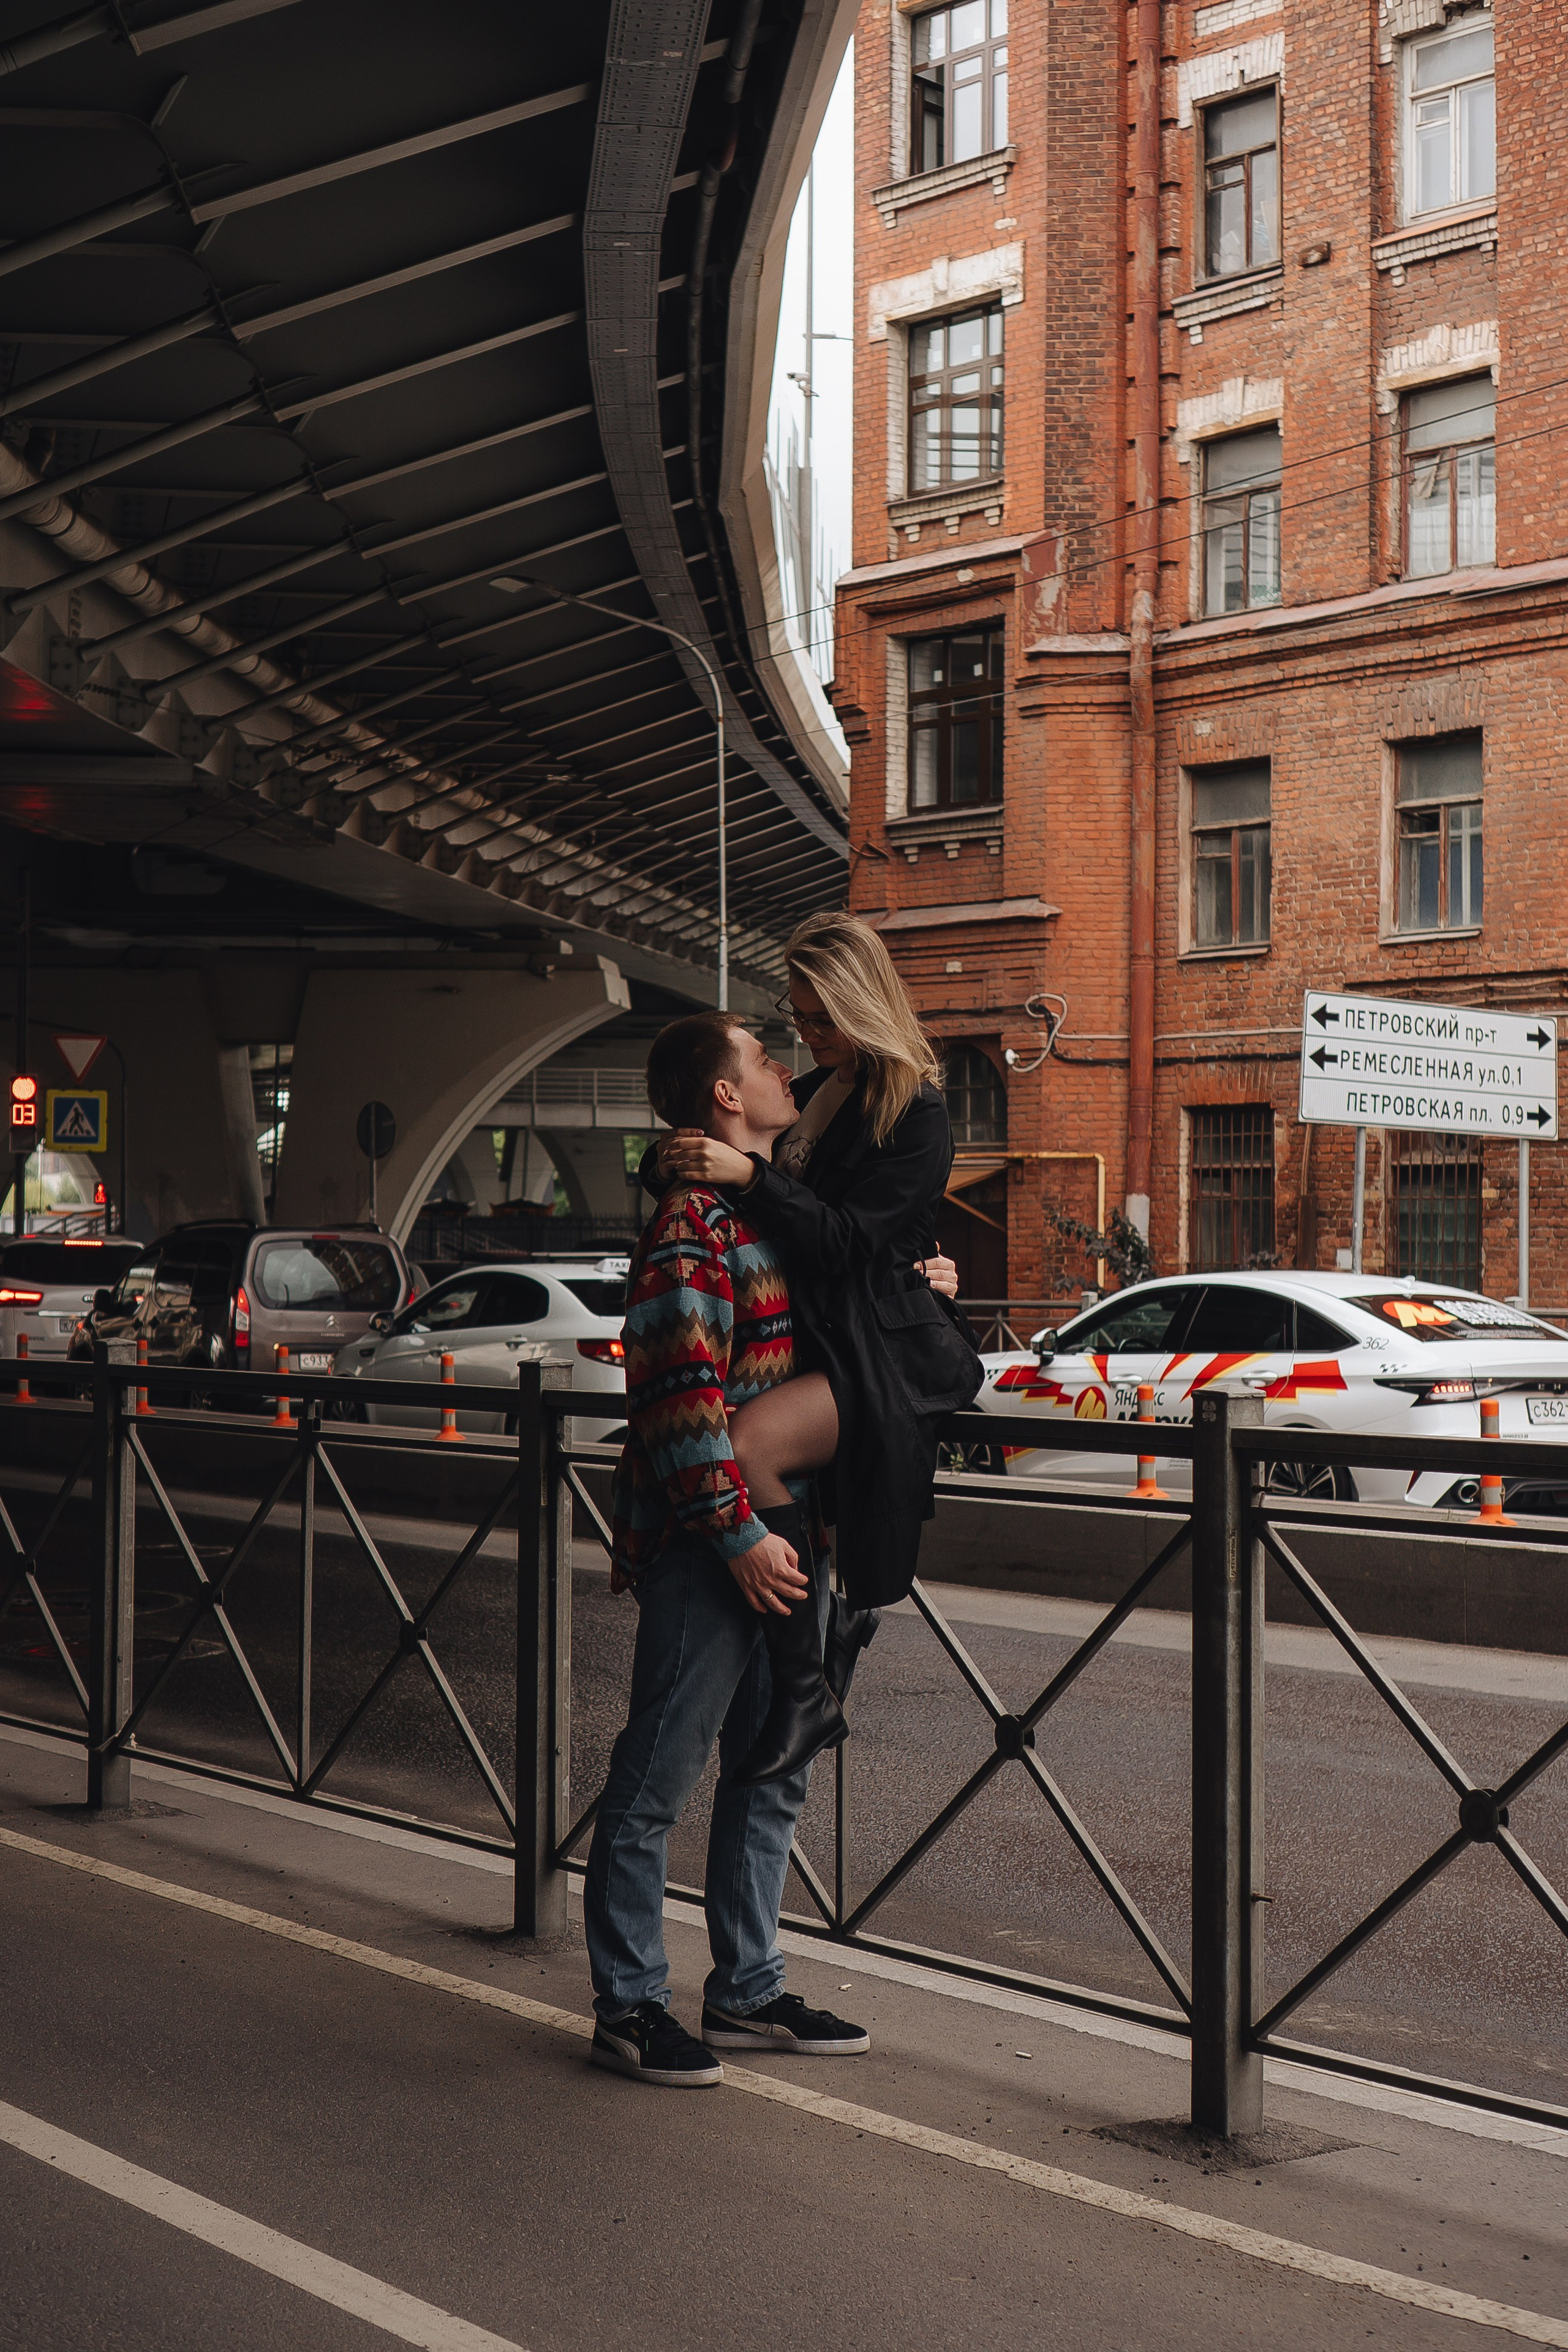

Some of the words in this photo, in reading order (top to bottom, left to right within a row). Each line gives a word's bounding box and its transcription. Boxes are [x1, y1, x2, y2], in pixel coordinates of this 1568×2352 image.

[1345, 1009, 1459, 1040] ПЕТРОВСКИЙ
[1465, 1025, 1498, 1047] пр-т
[1340, 1049, 1473, 1081] РЕМЕСЛЕННАЯ
[12, 1104, 36, 1125] 03
[1347, 1091, 1463, 1120] ПЕТРОВСКАЯ
[1469, 1109, 1493, 1123] пл.
[1502, 1105, 1525, 1128] 0,9
[1362, 1336, 1389, 1350] 362
[1534, 1401, 1568, 1417] С362
